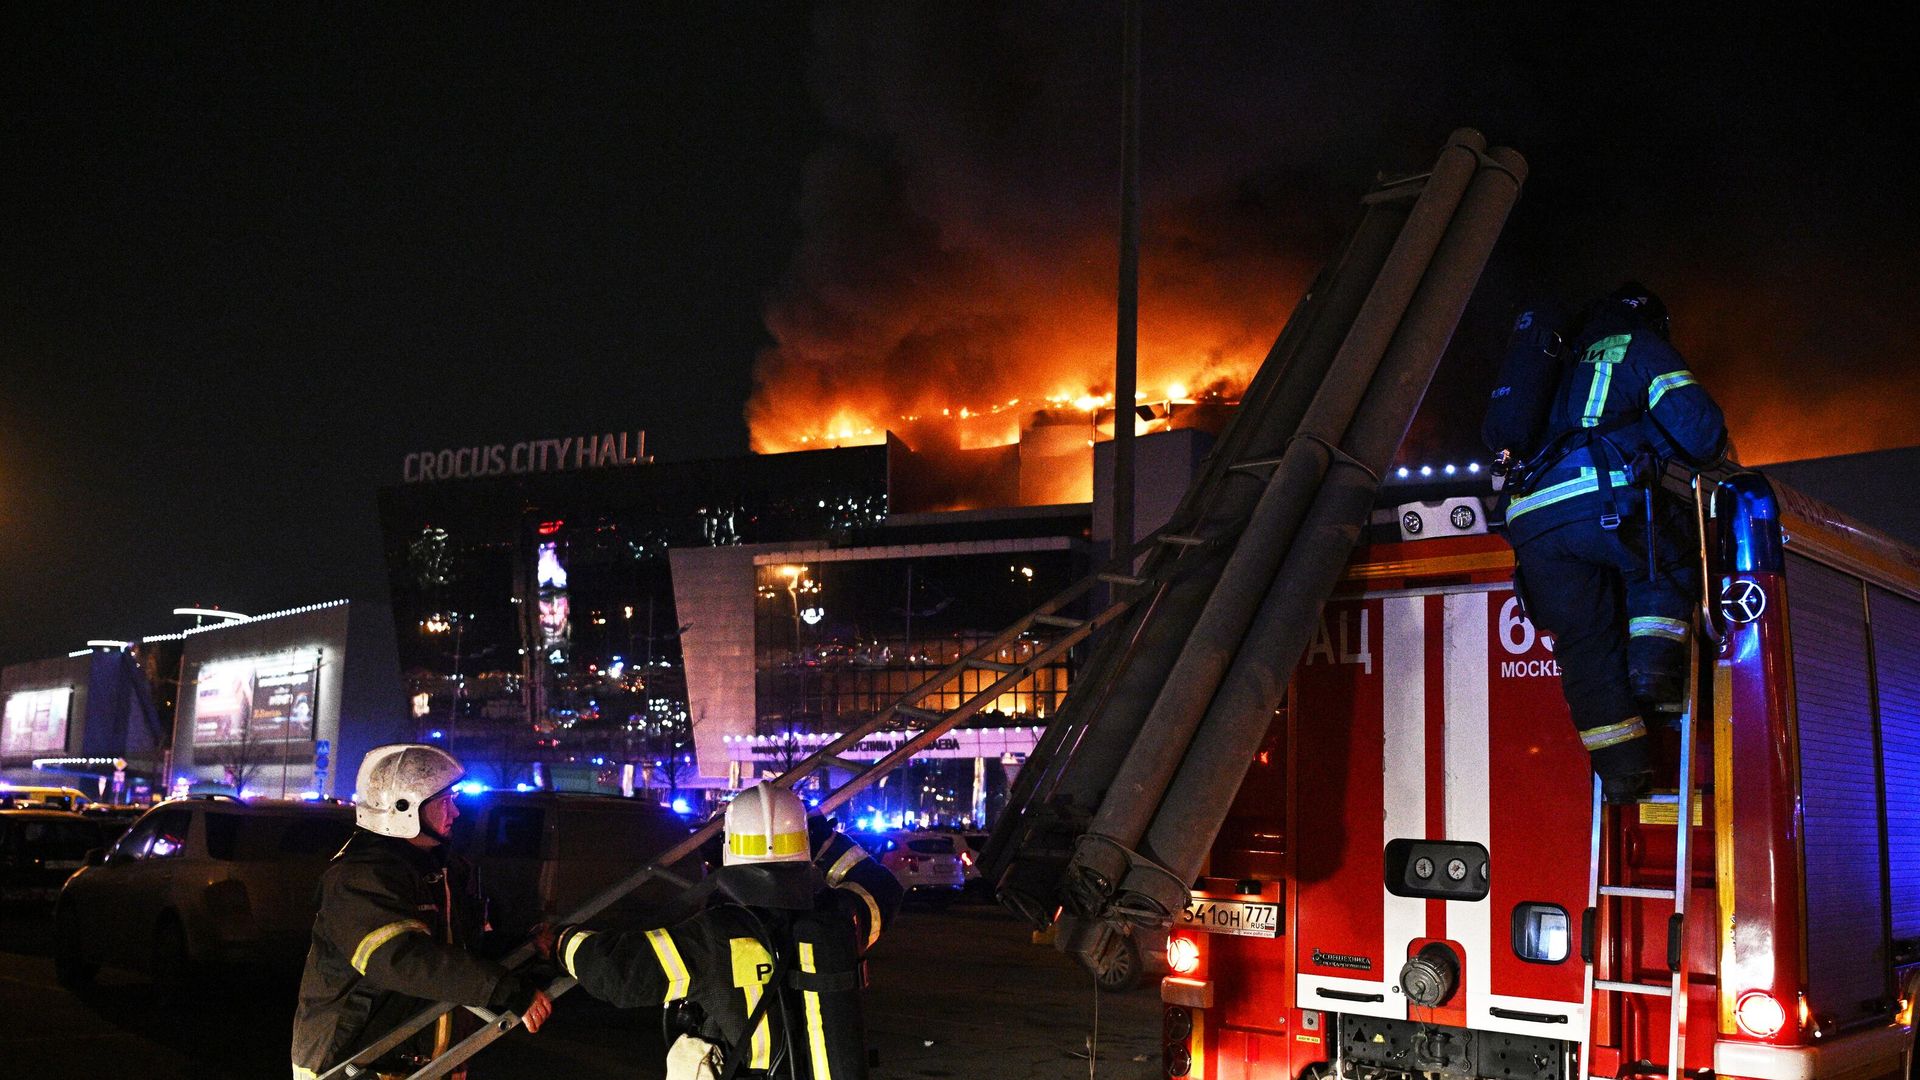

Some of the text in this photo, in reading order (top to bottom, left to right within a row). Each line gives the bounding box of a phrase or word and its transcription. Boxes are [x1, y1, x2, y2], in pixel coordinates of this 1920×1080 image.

[404, 430, 655, 482] CROCUS CITY HALL
[1244, 905, 1273, 923] 777
[1250, 922, 1265, 930] RUS
